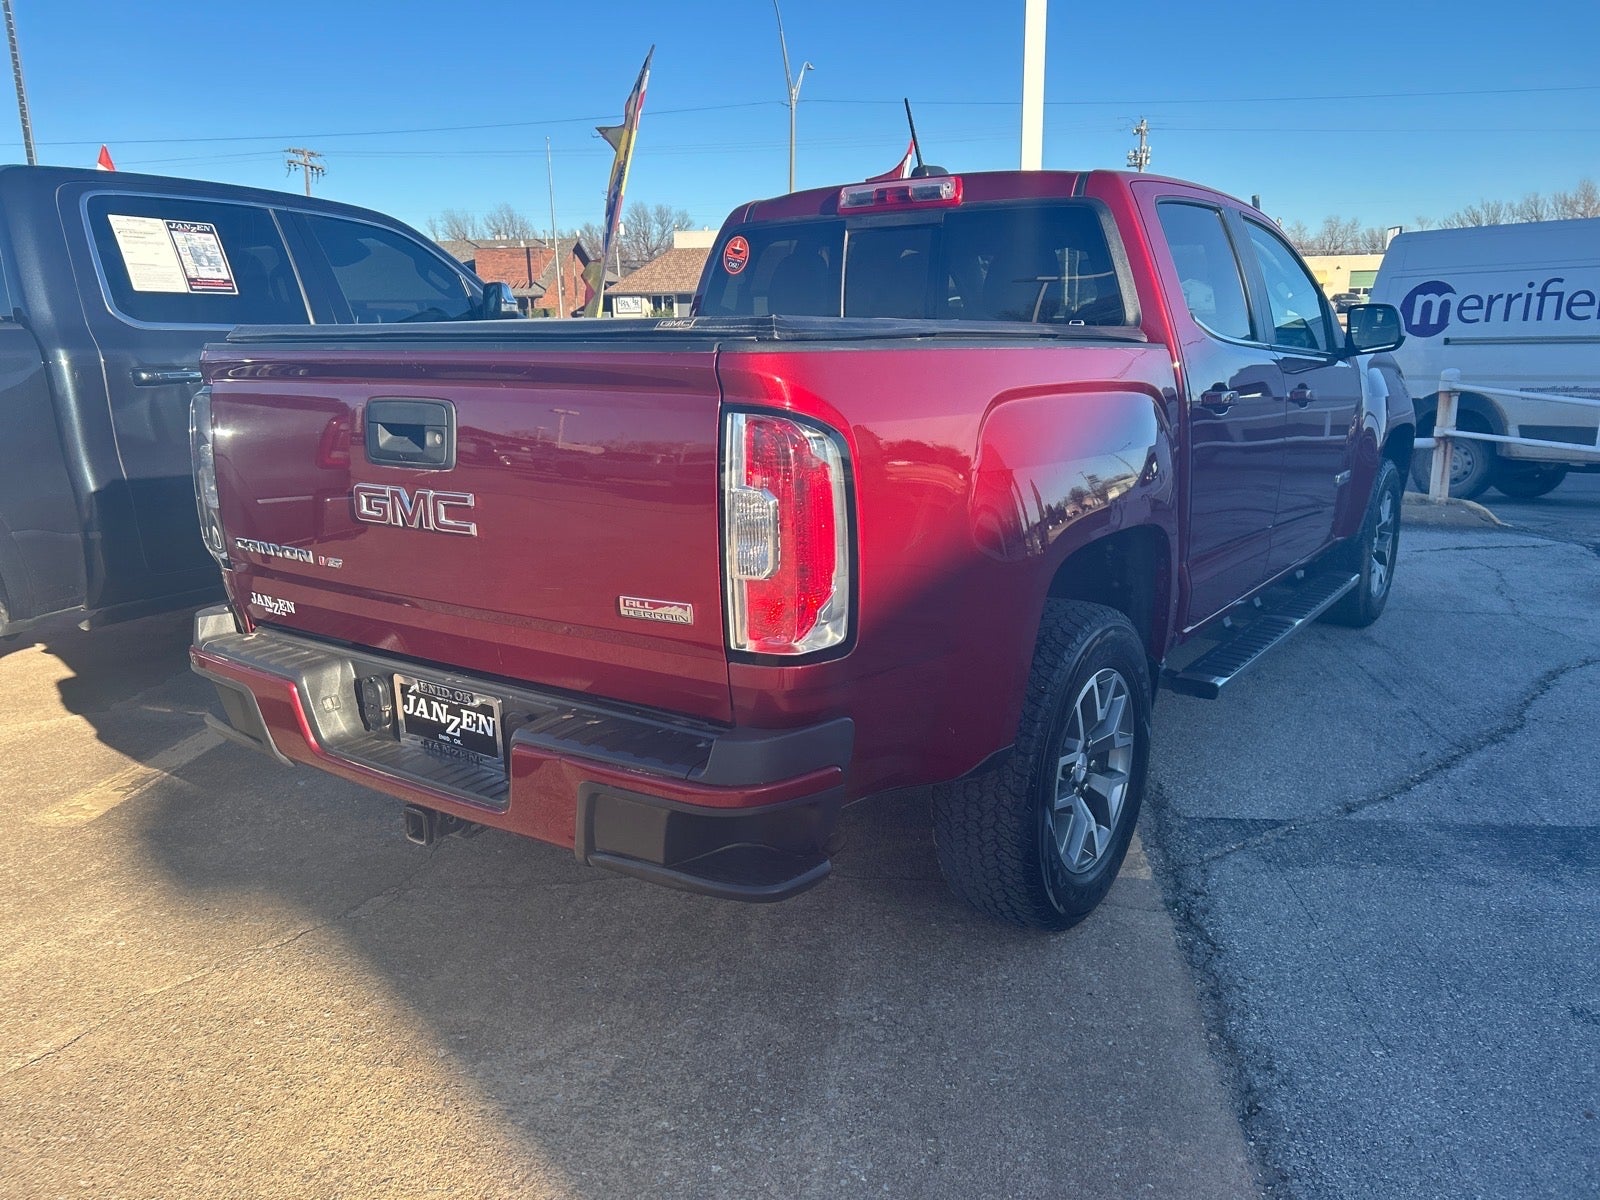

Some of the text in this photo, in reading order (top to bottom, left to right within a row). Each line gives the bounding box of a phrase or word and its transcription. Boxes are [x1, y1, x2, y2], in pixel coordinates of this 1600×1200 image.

[169, 222, 211, 233] JANZEN
[1411, 277, 1600, 326] merrifie
[353, 482, 477, 536] GMC
[235, 537, 314, 564] CANYON
[251, 591, 296, 615] JANZEN
[625, 599, 653, 609] ALL
[623, 608, 689, 623] TERRAIN
[454, 690, 472, 703] OK
[403, 694, 496, 737] JANZEN
[424, 741, 478, 762] JANZEN
